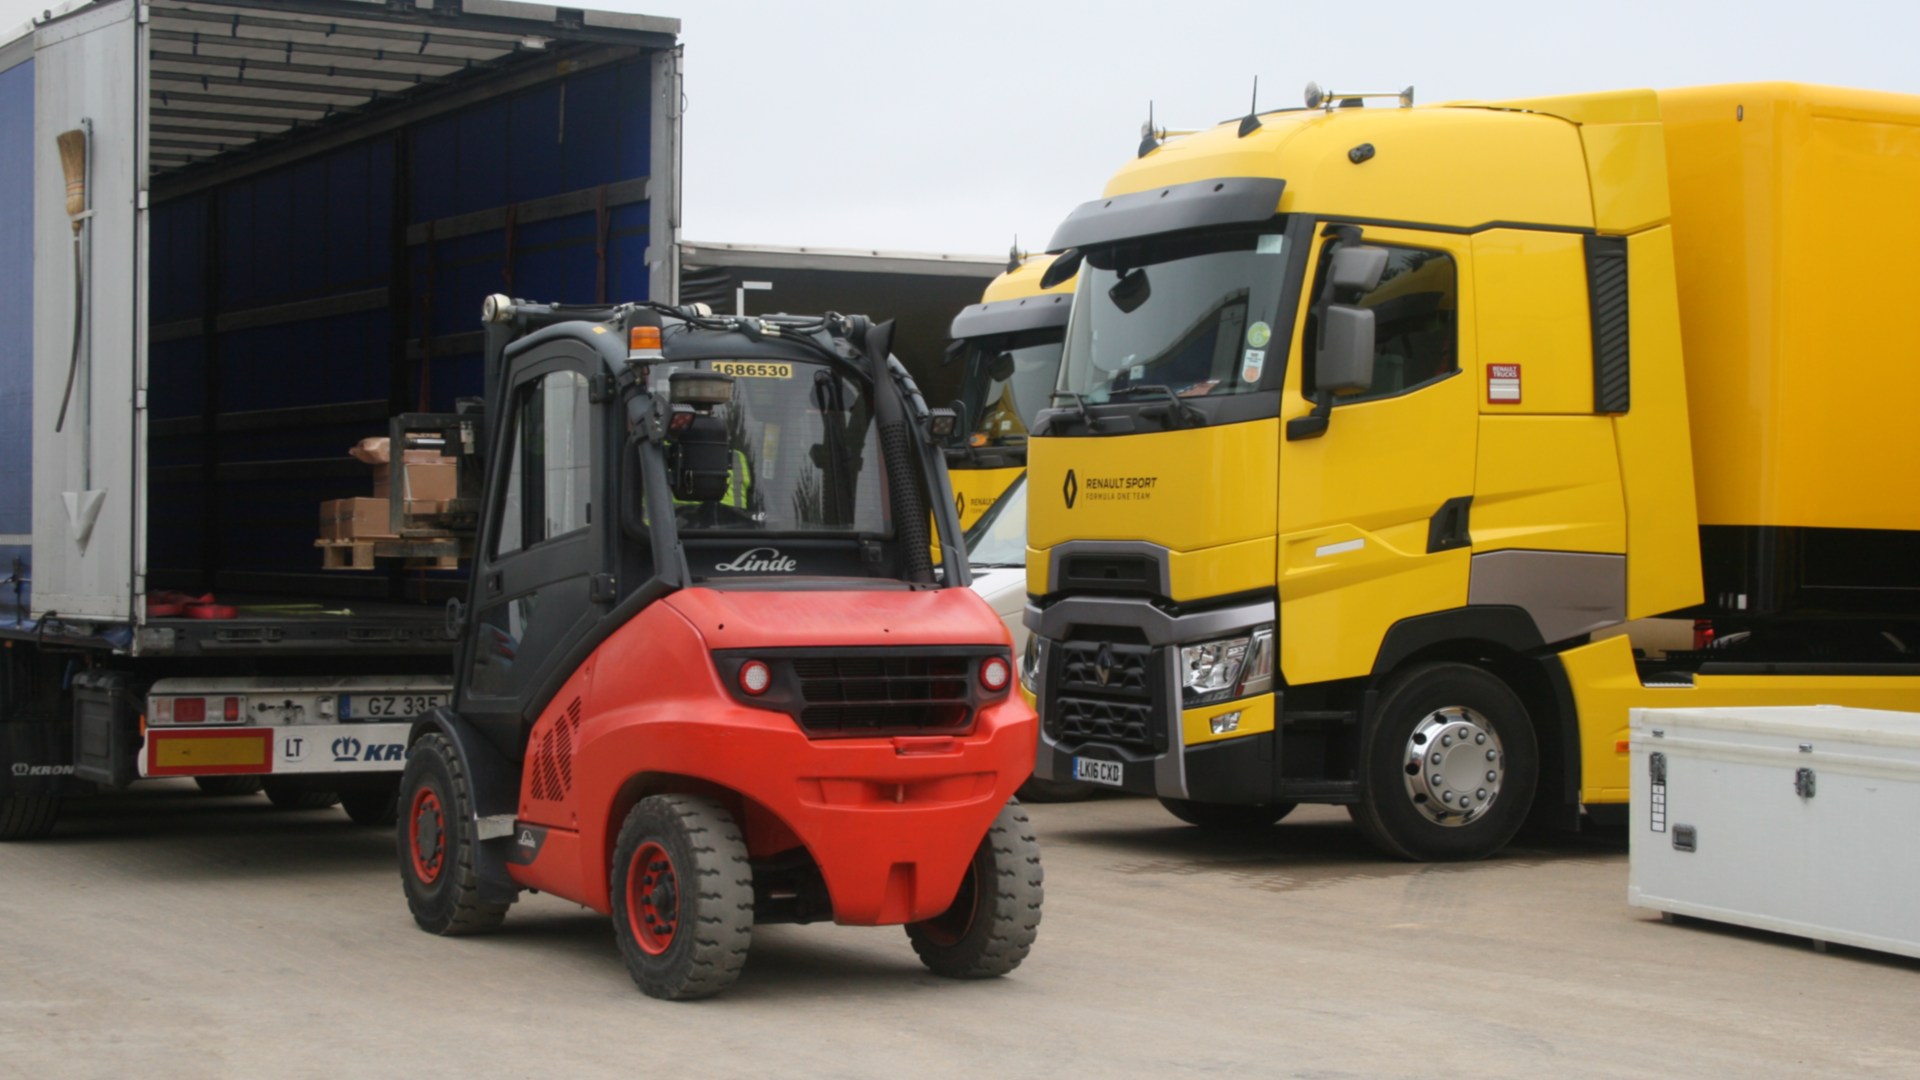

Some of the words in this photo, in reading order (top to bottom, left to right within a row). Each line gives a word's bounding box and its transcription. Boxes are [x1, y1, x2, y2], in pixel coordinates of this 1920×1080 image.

[713, 364, 789, 377] 1686530
[1086, 478, 1124, 489] RENAULT
[1126, 477, 1157, 489] SPORT
[1086, 492, 1115, 501] FORMULA
[1117, 492, 1130, 500] ONE
[1133, 492, 1151, 500] TEAM
[715, 547, 797, 572] Linde
[368, 697, 396, 716] GZ
[285, 738, 303, 757] LT
[1079, 760, 1099, 779] LK16
[1100, 763, 1119, 782] CXD
